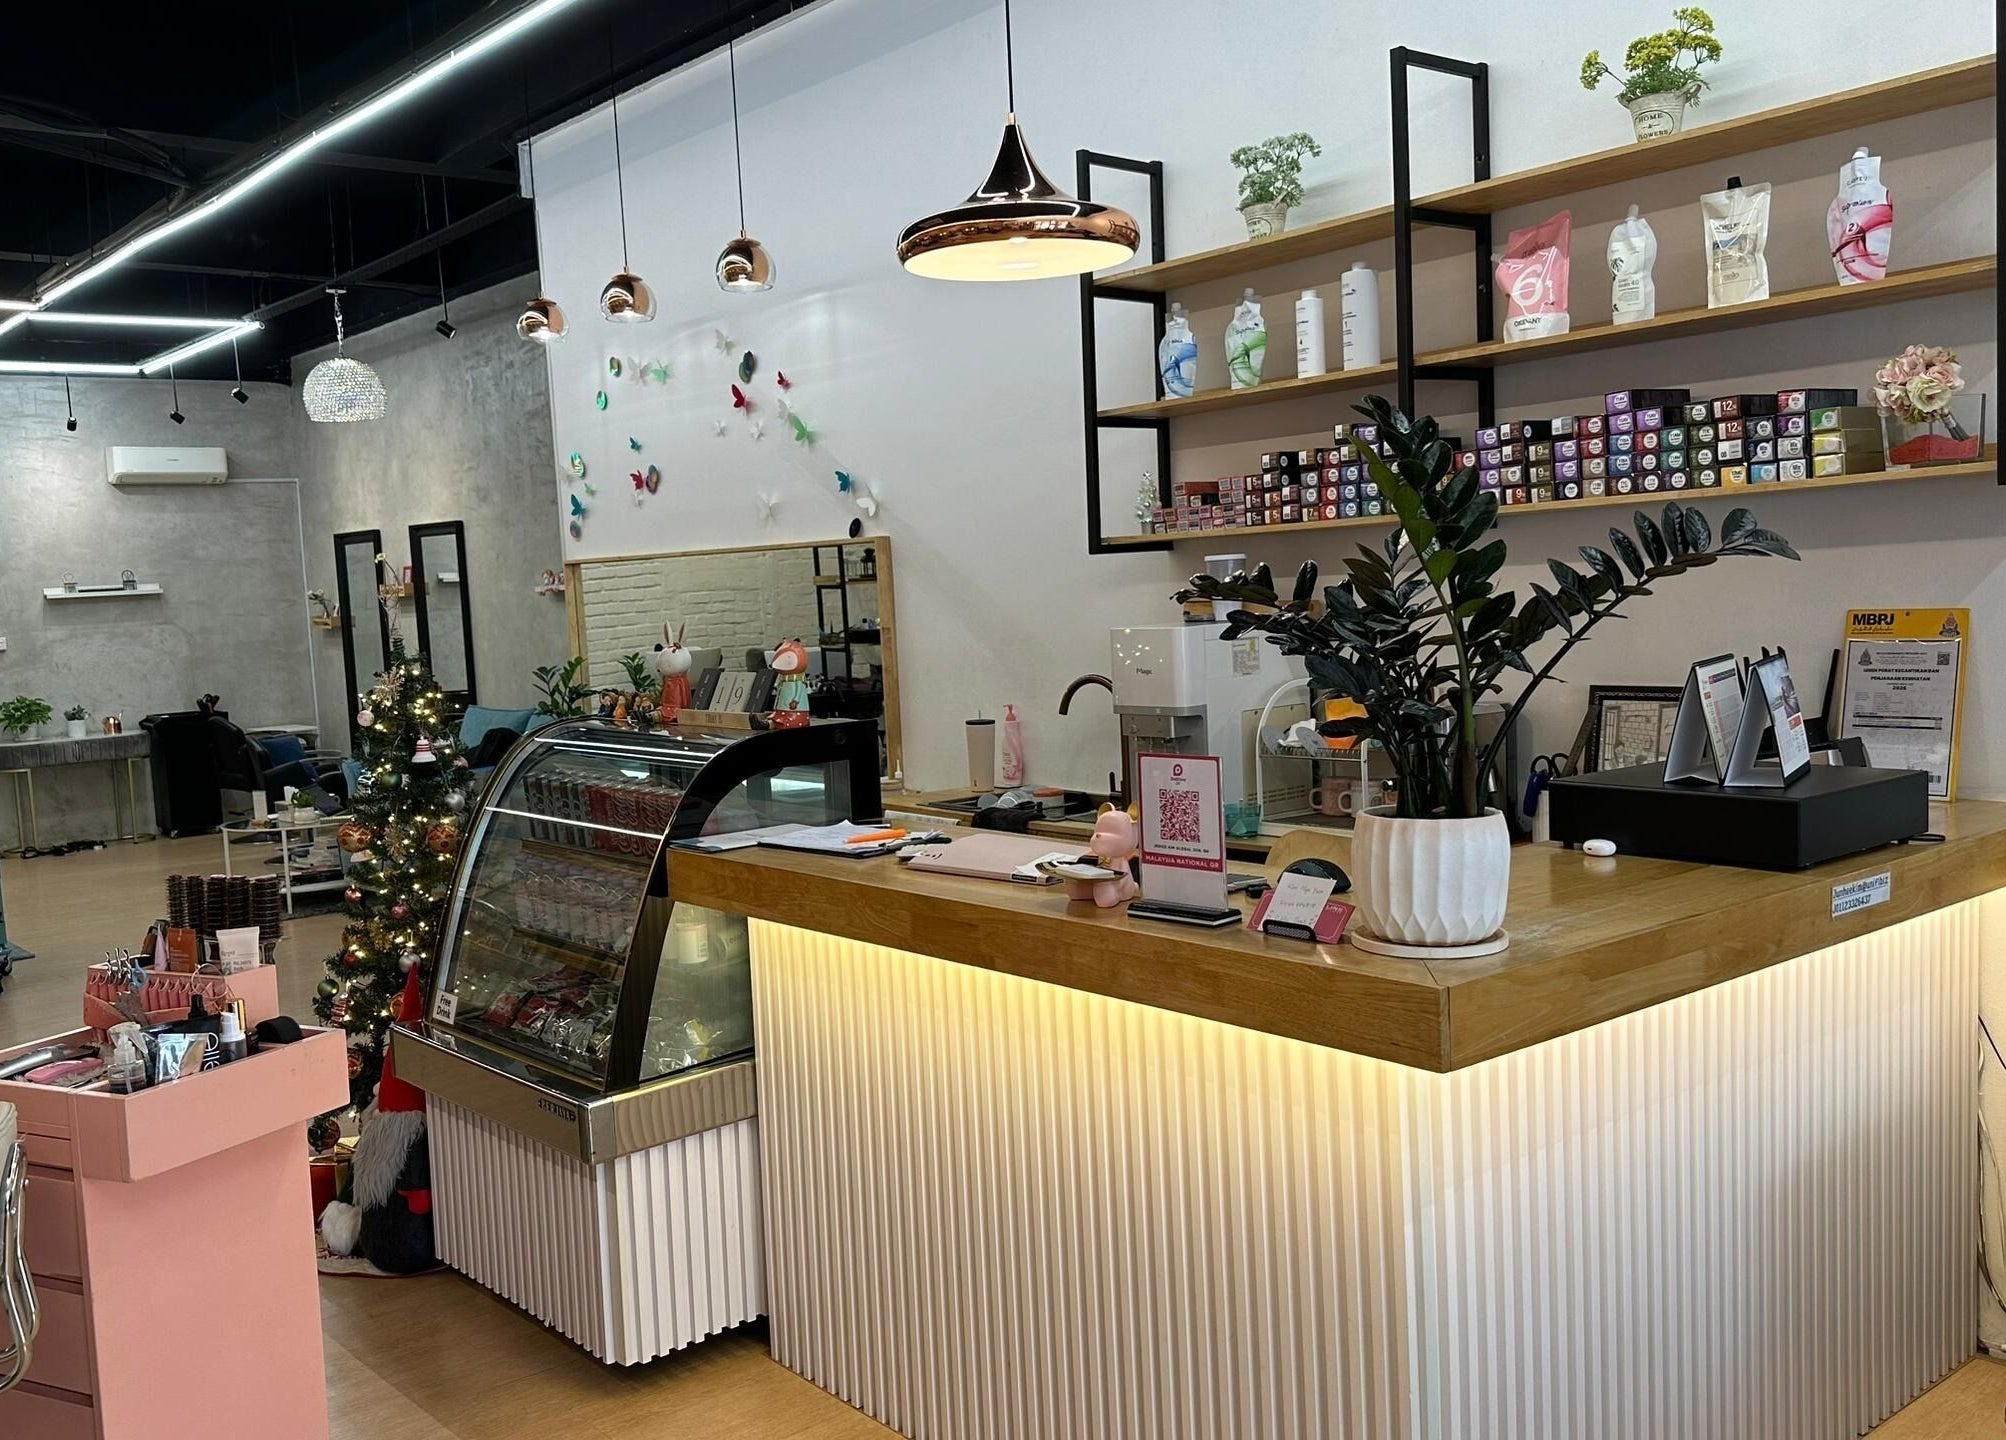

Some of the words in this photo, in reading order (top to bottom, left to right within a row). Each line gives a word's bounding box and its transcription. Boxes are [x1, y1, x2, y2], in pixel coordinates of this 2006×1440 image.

[1638, 113, 1664, 123] HOME
[1146, 855, 1175, 864] MALAYSIA
[1177, 858, 1208, 868] NATIONAL
[440, 994, 452, 1006] Free
[437, 1006, 451, 1019] Drink
